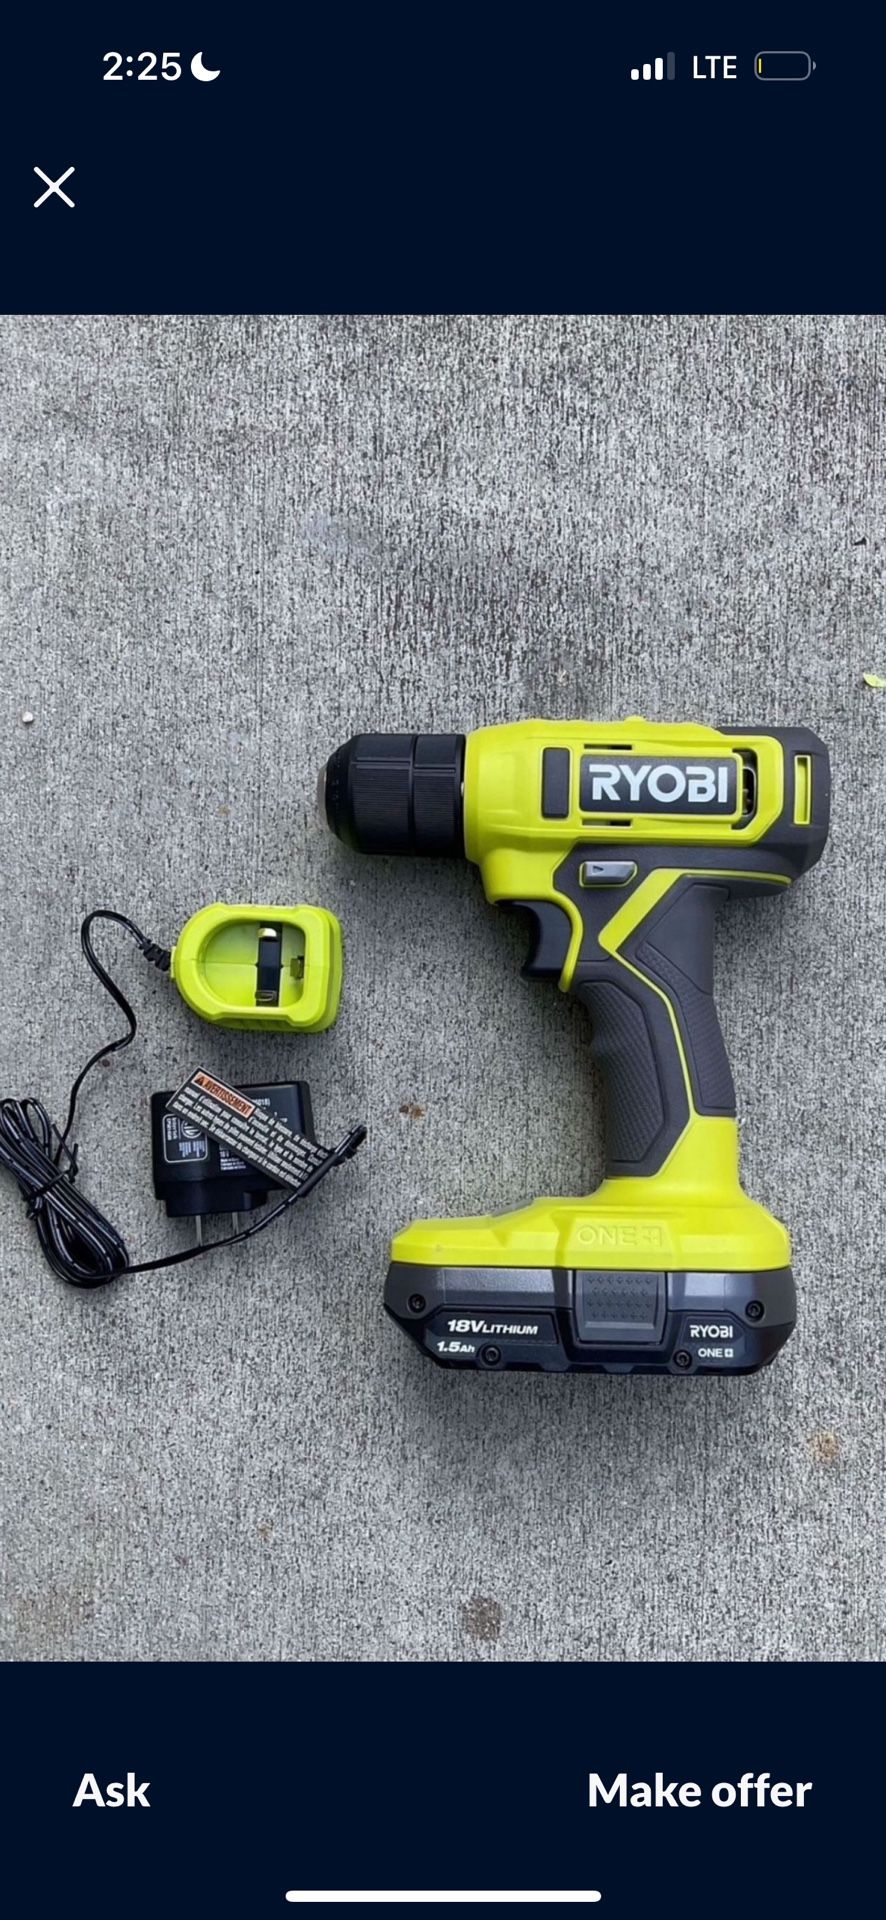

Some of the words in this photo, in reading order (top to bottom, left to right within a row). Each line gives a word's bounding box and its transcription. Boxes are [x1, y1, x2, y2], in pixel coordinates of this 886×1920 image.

[103, 52, 181, 80] 2:25
[694, 56, 736, 78] LTE
[589, 764, 728, 803] RYOBI
[203, 1078, 251, 1116] AVERTISSEMENT
[438, 1341, 474, 1352] 1.5Ah
[690, 1325, 732, 1337] RYOBI
[72, 1773, 150, 1807] Ask
[589, 1773, 701, 1807] Make
[712, 1773, 812, 1807] offer
